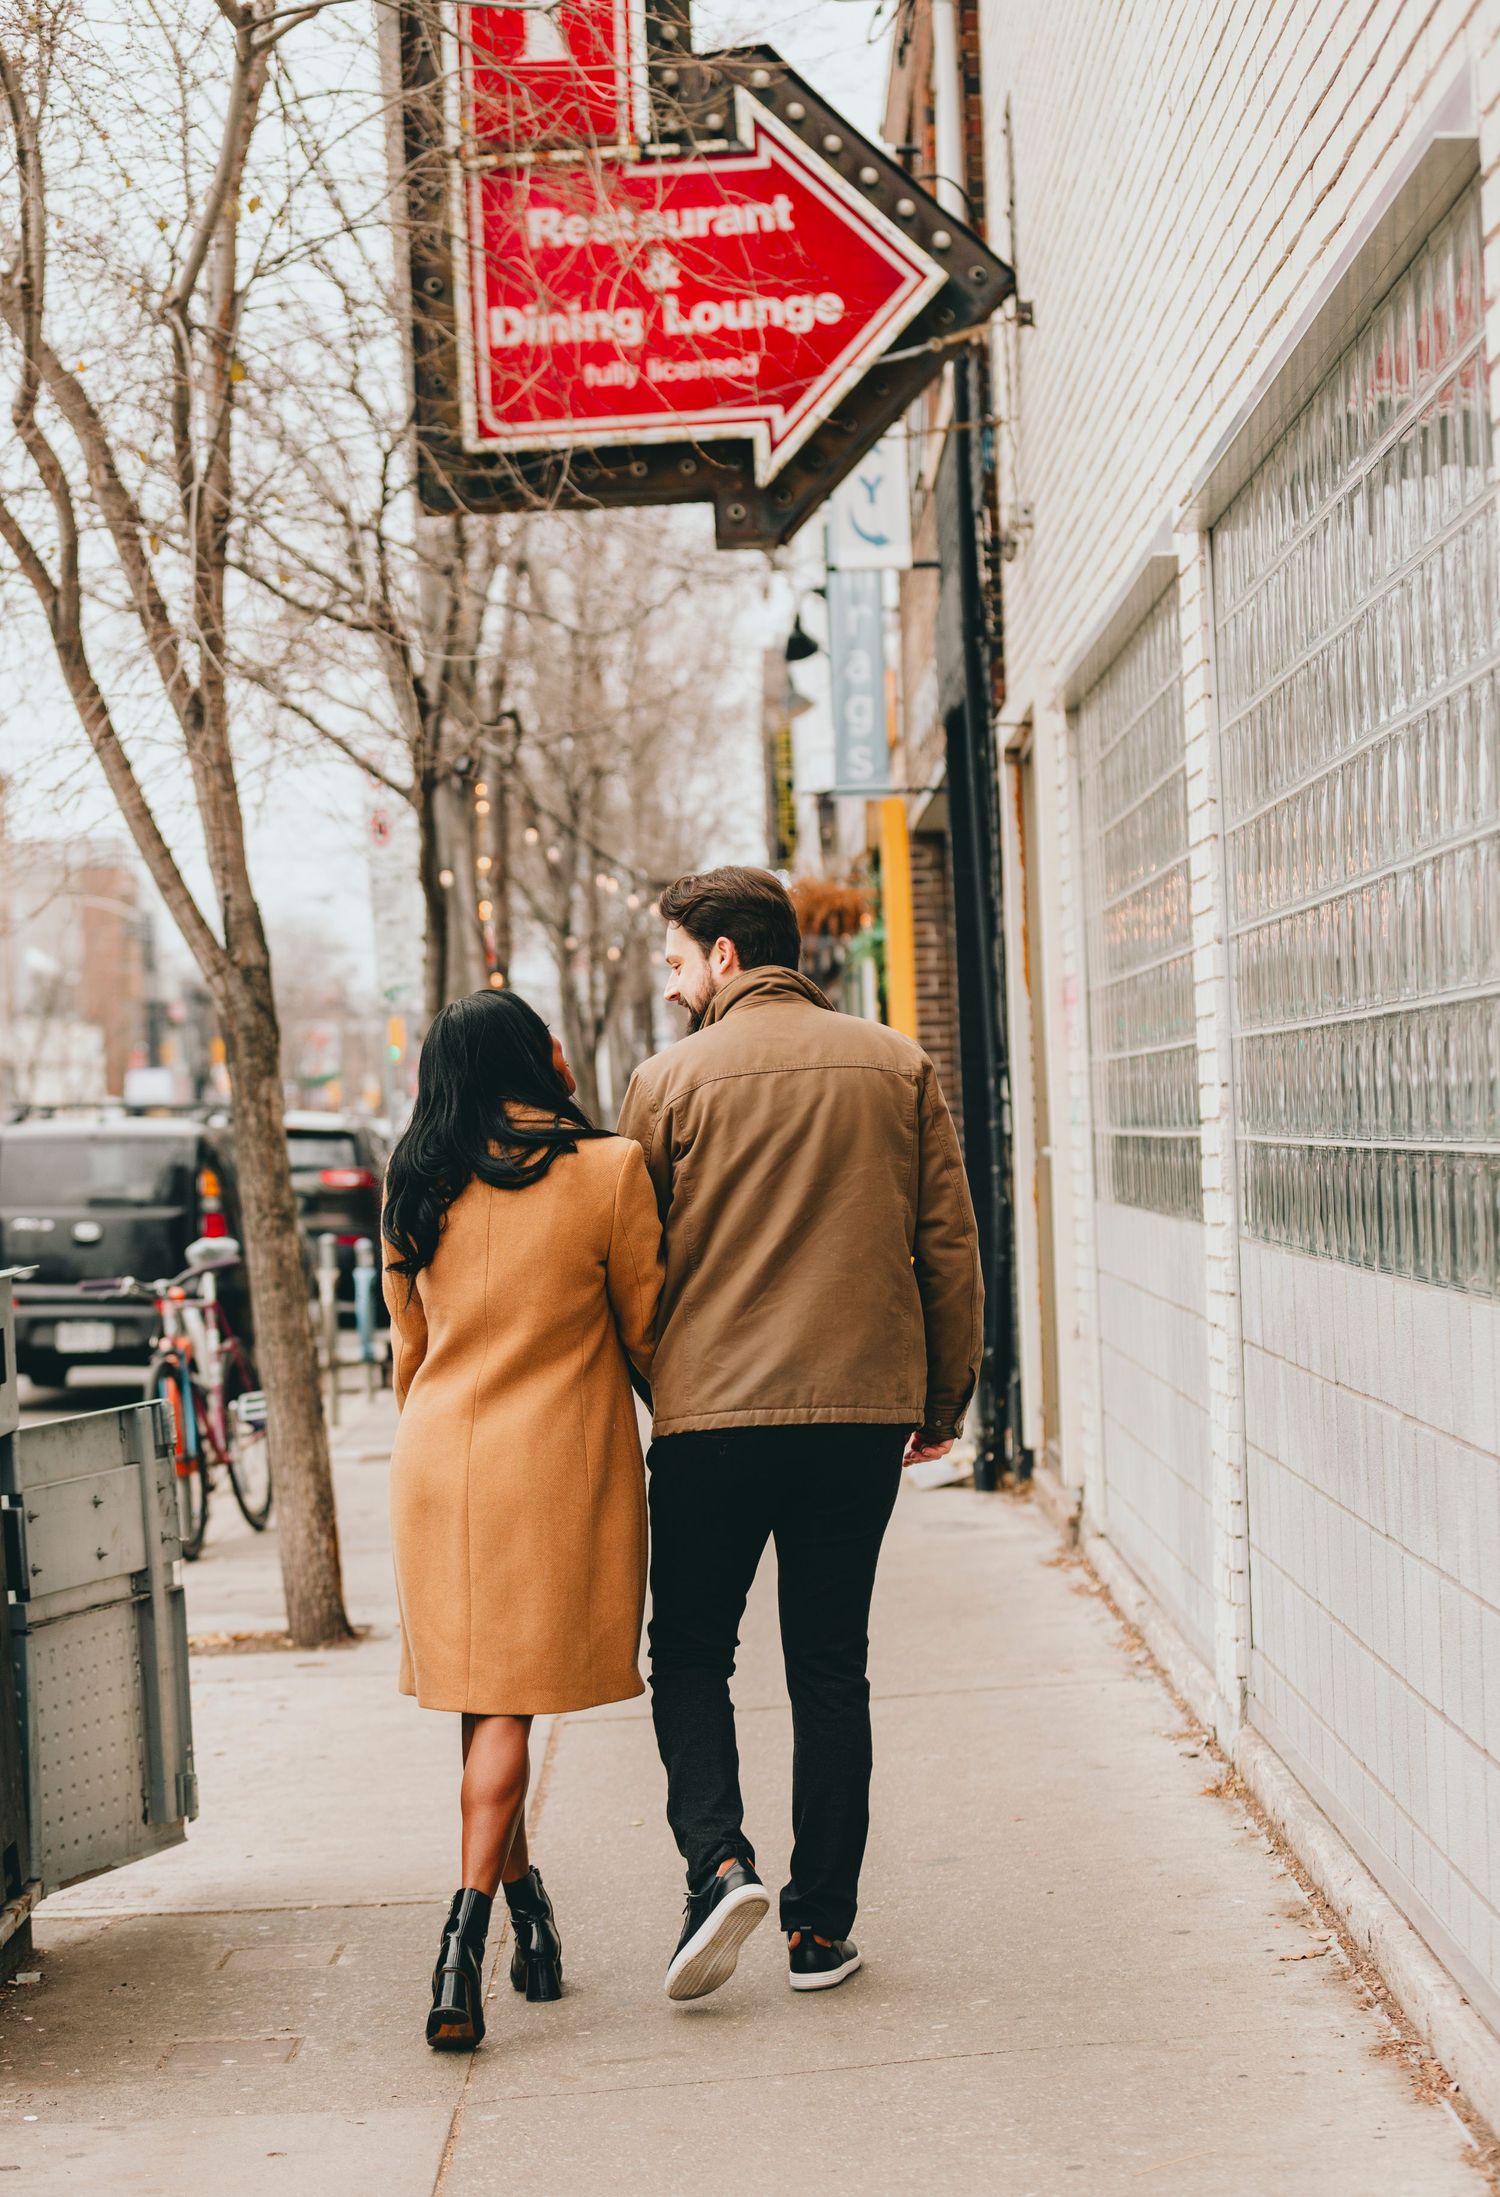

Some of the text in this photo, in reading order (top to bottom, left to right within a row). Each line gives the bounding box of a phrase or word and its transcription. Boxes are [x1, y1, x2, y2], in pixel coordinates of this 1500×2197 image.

[526, 193, 796, 249] Restaurant
[644, 250, 683, 288] &
[490, 291, 845, 347] Dining Lounge
[583, 361, 640, 390] fully
